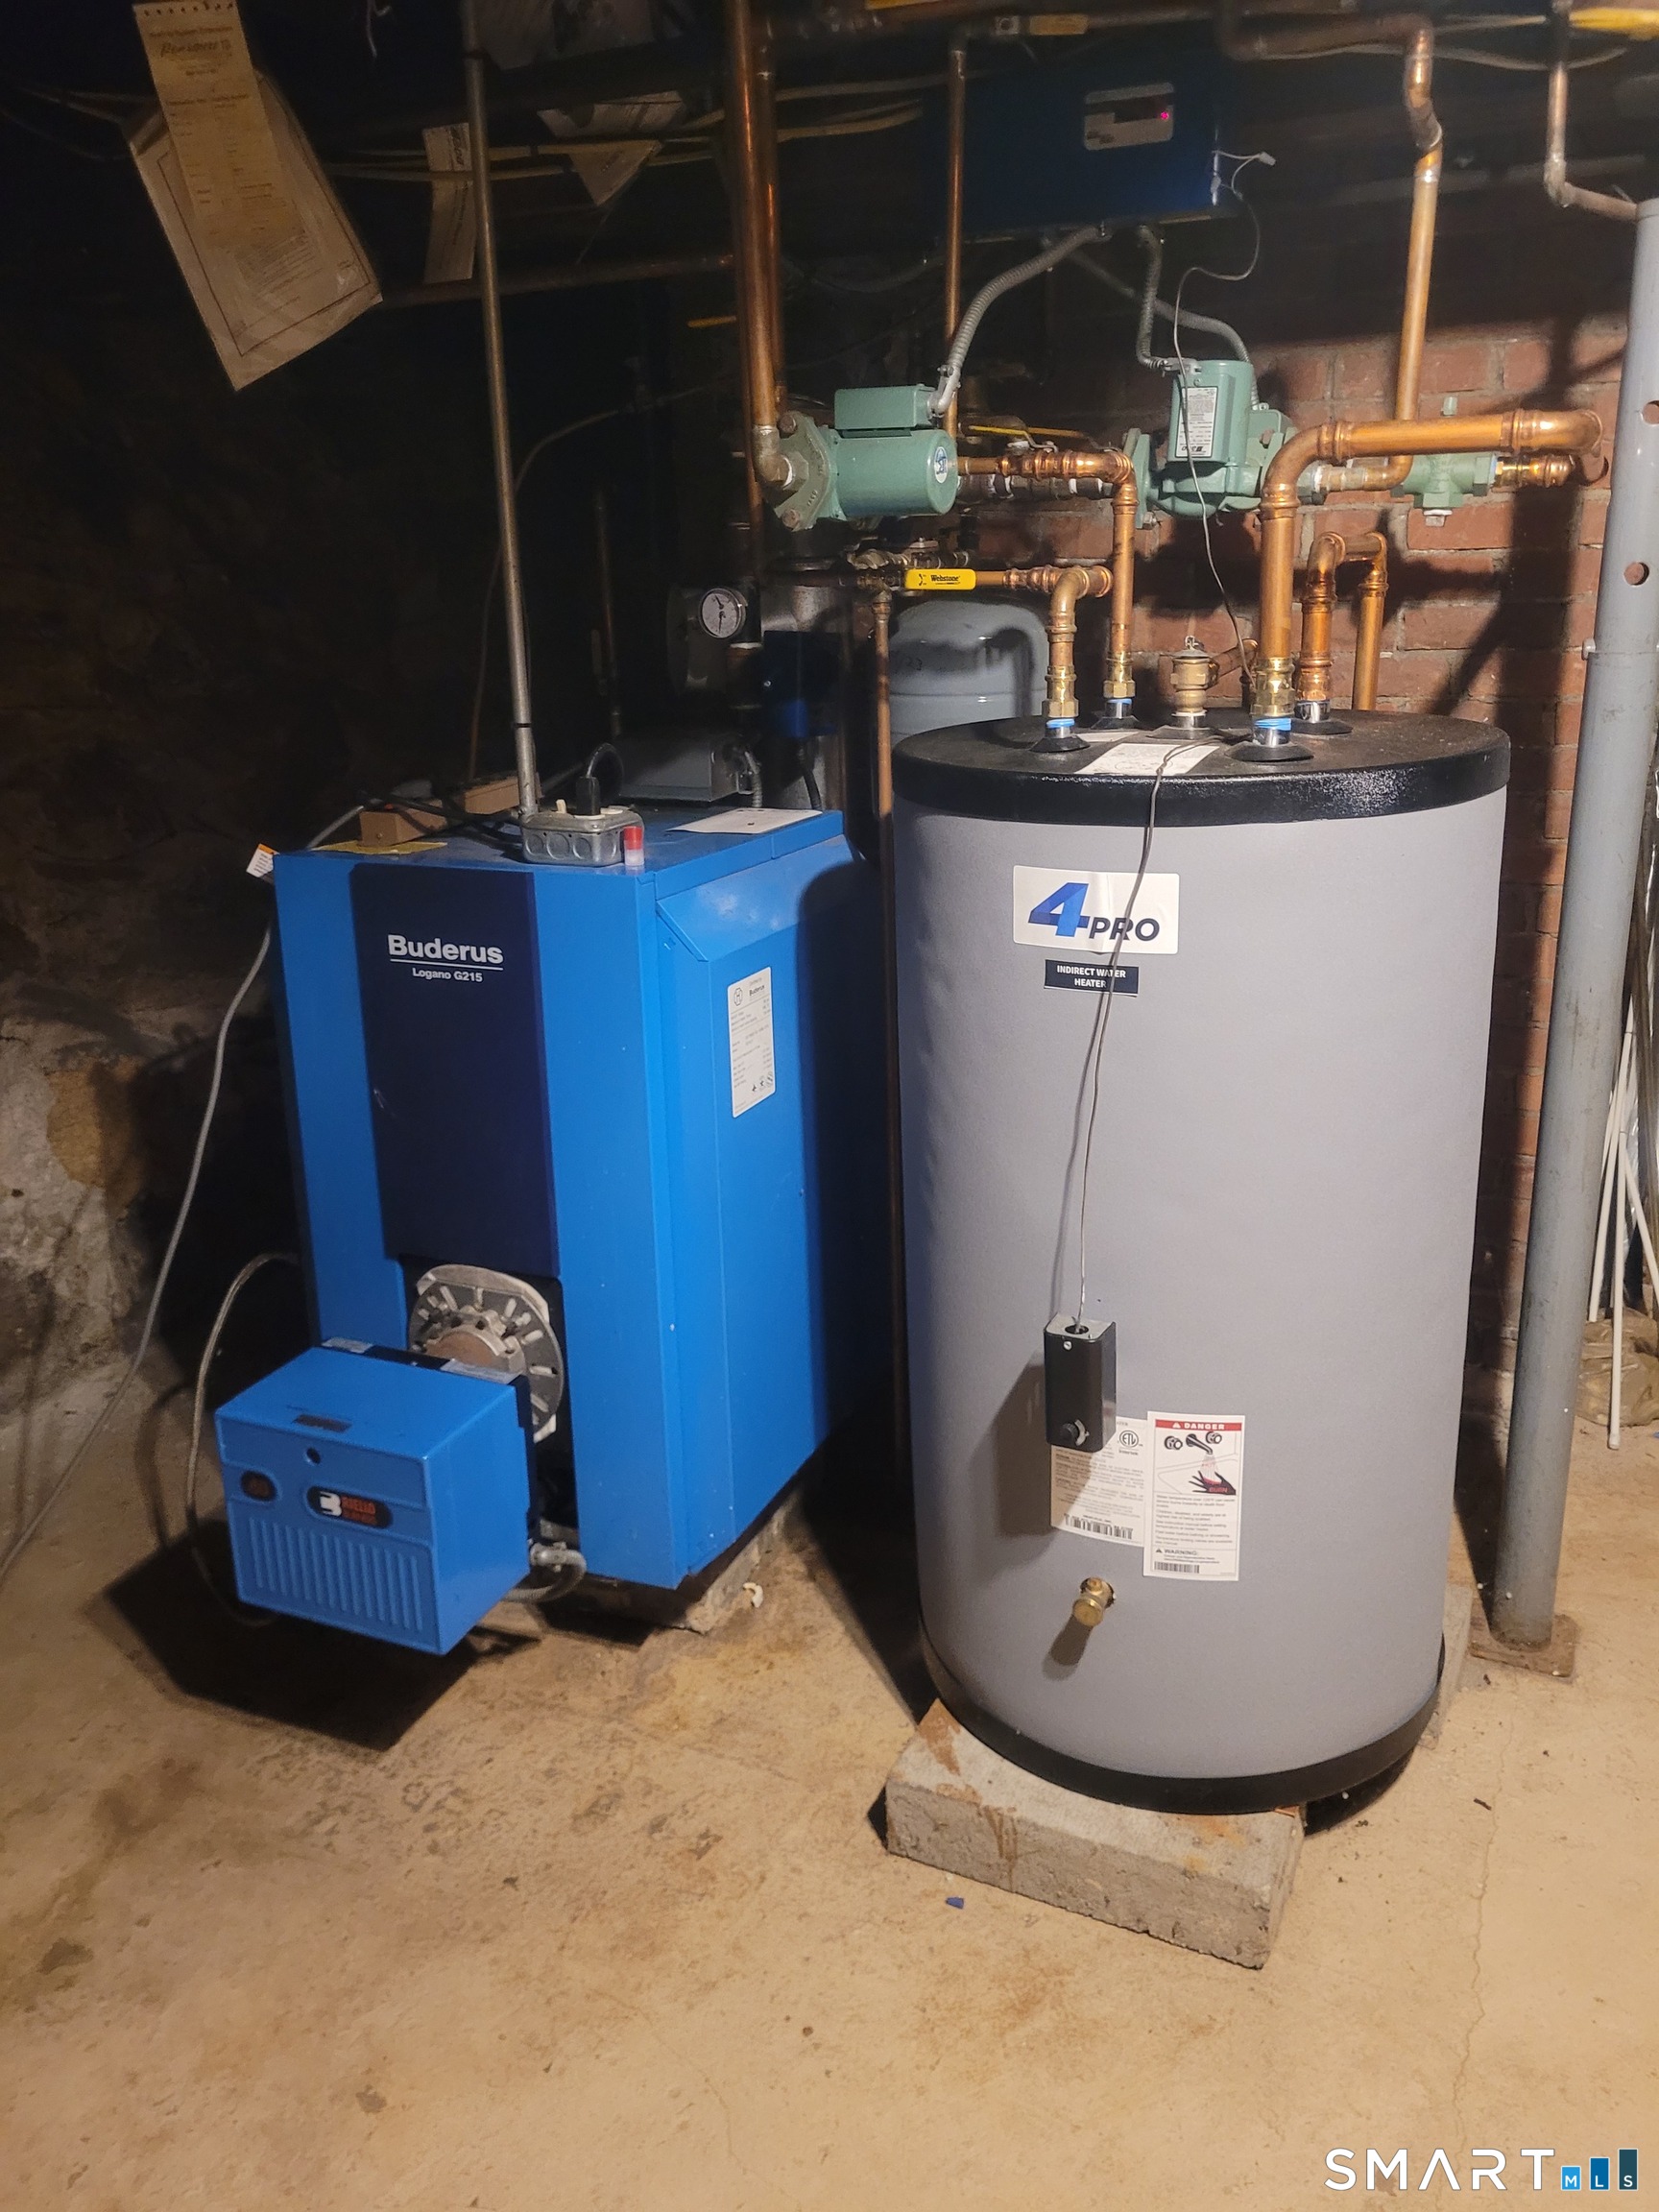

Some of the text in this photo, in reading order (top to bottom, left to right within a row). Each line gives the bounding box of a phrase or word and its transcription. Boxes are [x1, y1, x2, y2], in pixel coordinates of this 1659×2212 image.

[388, 934, 504, 964] Buderus
[412, 968, 483, 982] Logano G215
[1057, 964, 1126, 978] INDIRECT WATER
[1074, 977, 1107, 989] HEATER
[1184, 1422, 1225, 1431] DANGER
